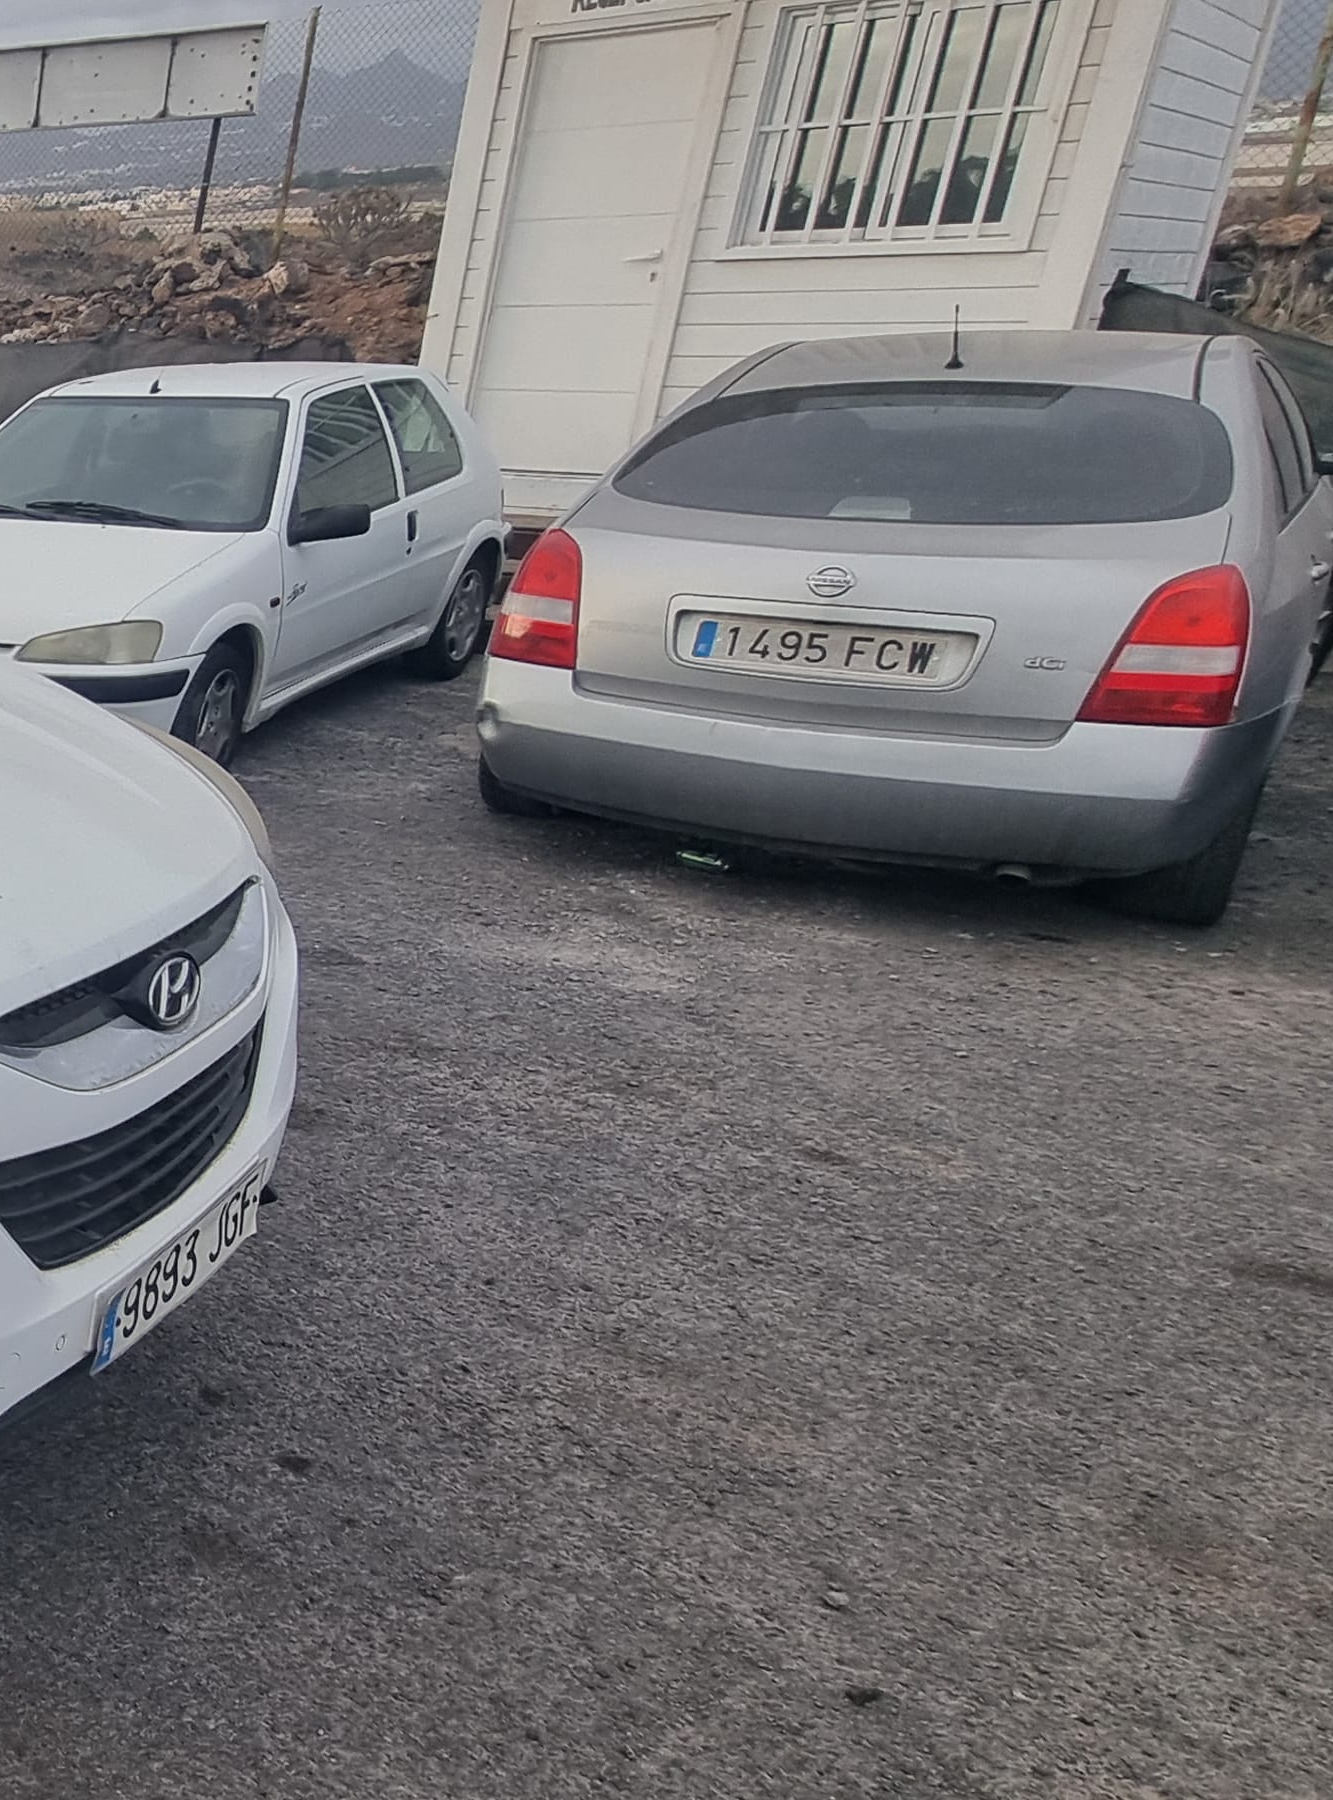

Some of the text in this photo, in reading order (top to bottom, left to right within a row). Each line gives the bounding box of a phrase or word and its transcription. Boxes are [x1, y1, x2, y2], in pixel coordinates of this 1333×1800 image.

[726, 626, 936, 675] 1495 FCW
[122, 1174, 259, 1339] 9893 JGF
